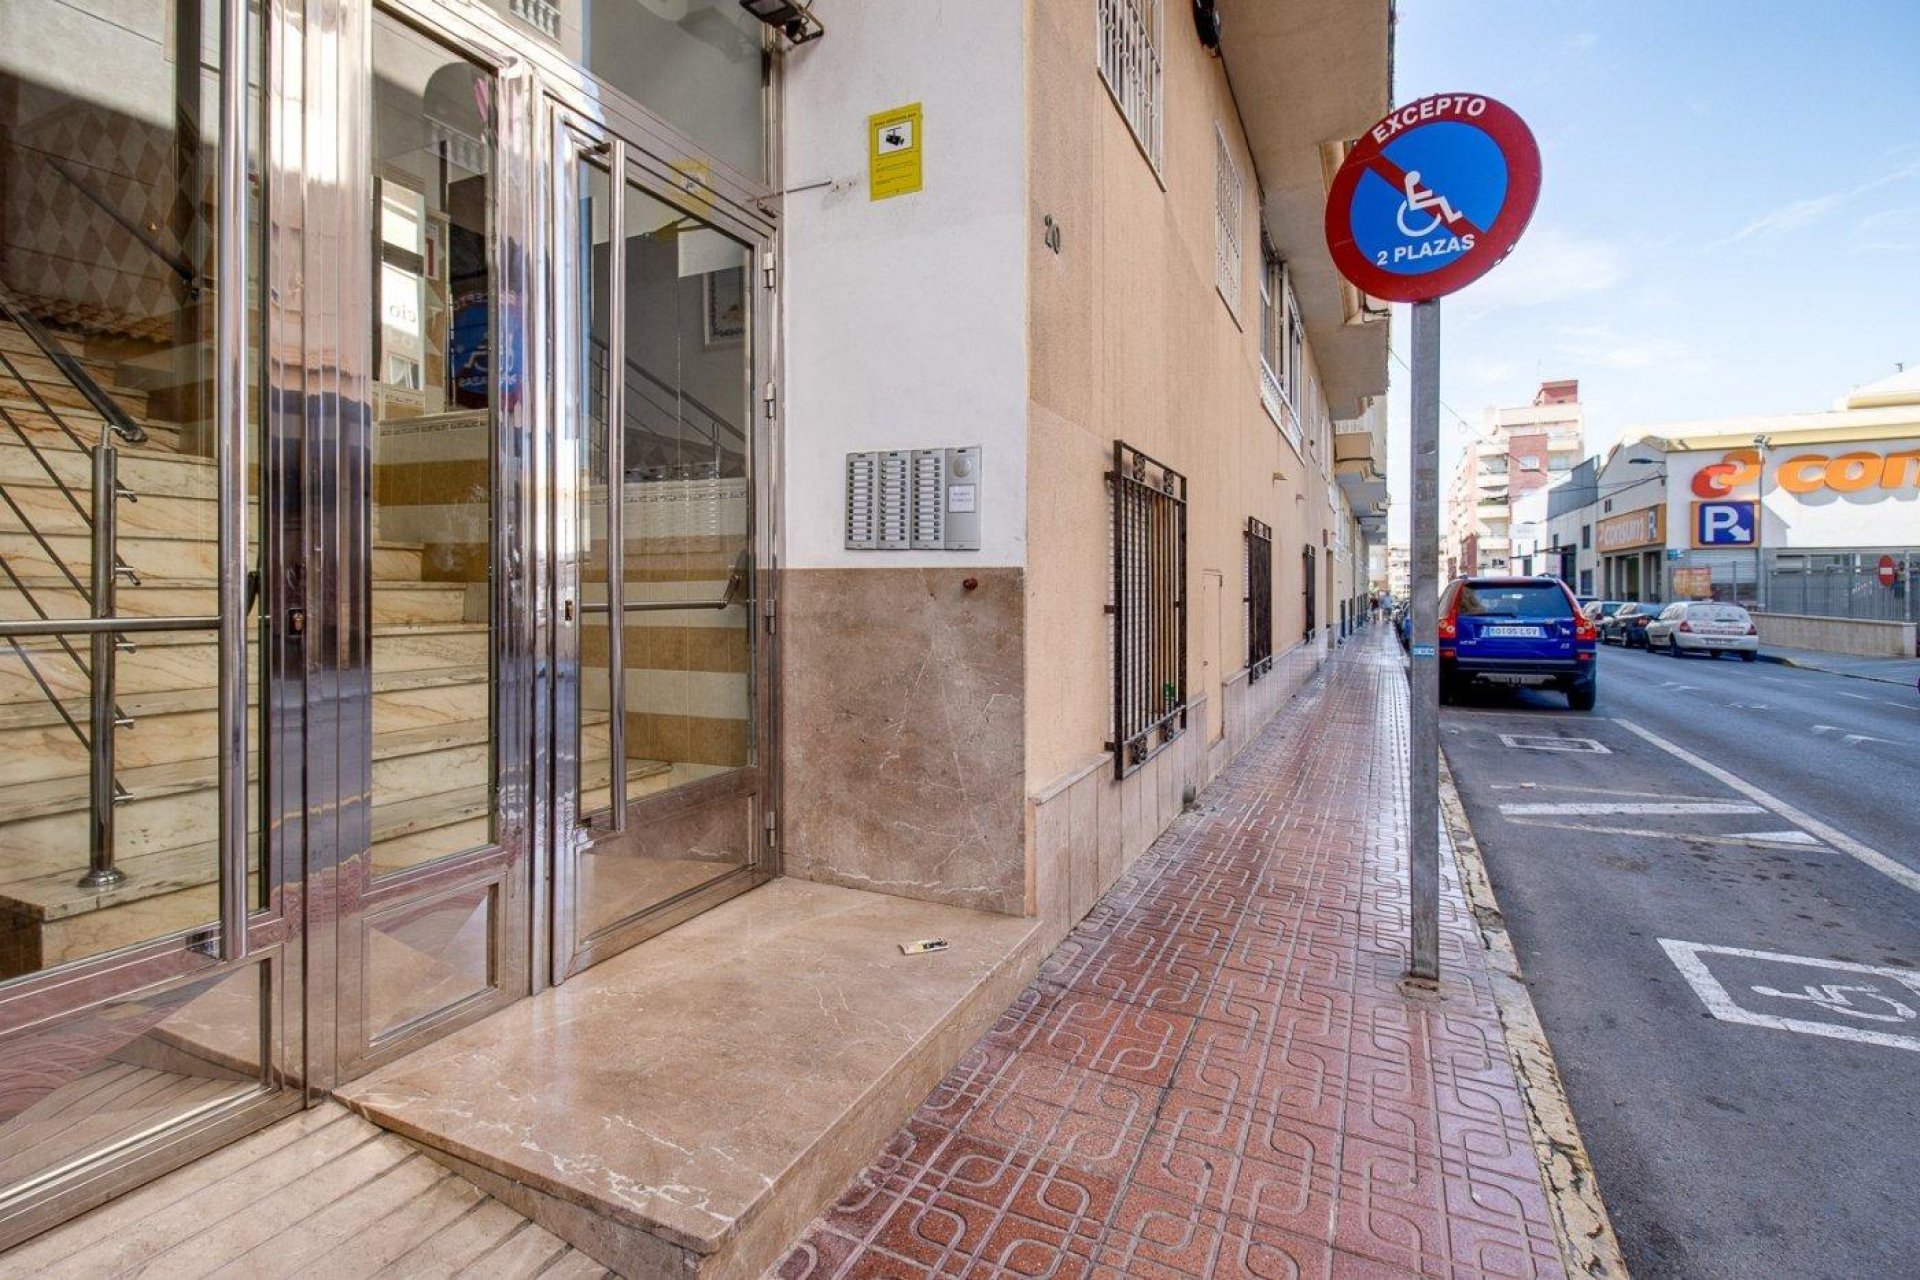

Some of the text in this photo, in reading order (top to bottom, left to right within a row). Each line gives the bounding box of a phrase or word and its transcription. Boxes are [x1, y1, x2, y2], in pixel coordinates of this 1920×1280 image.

[1372, 96, 1486, 144] EXCEPTO
[1377, 234, 1475, 266] 2 PLAZAS
[1704, 505, 1739, 542] P
